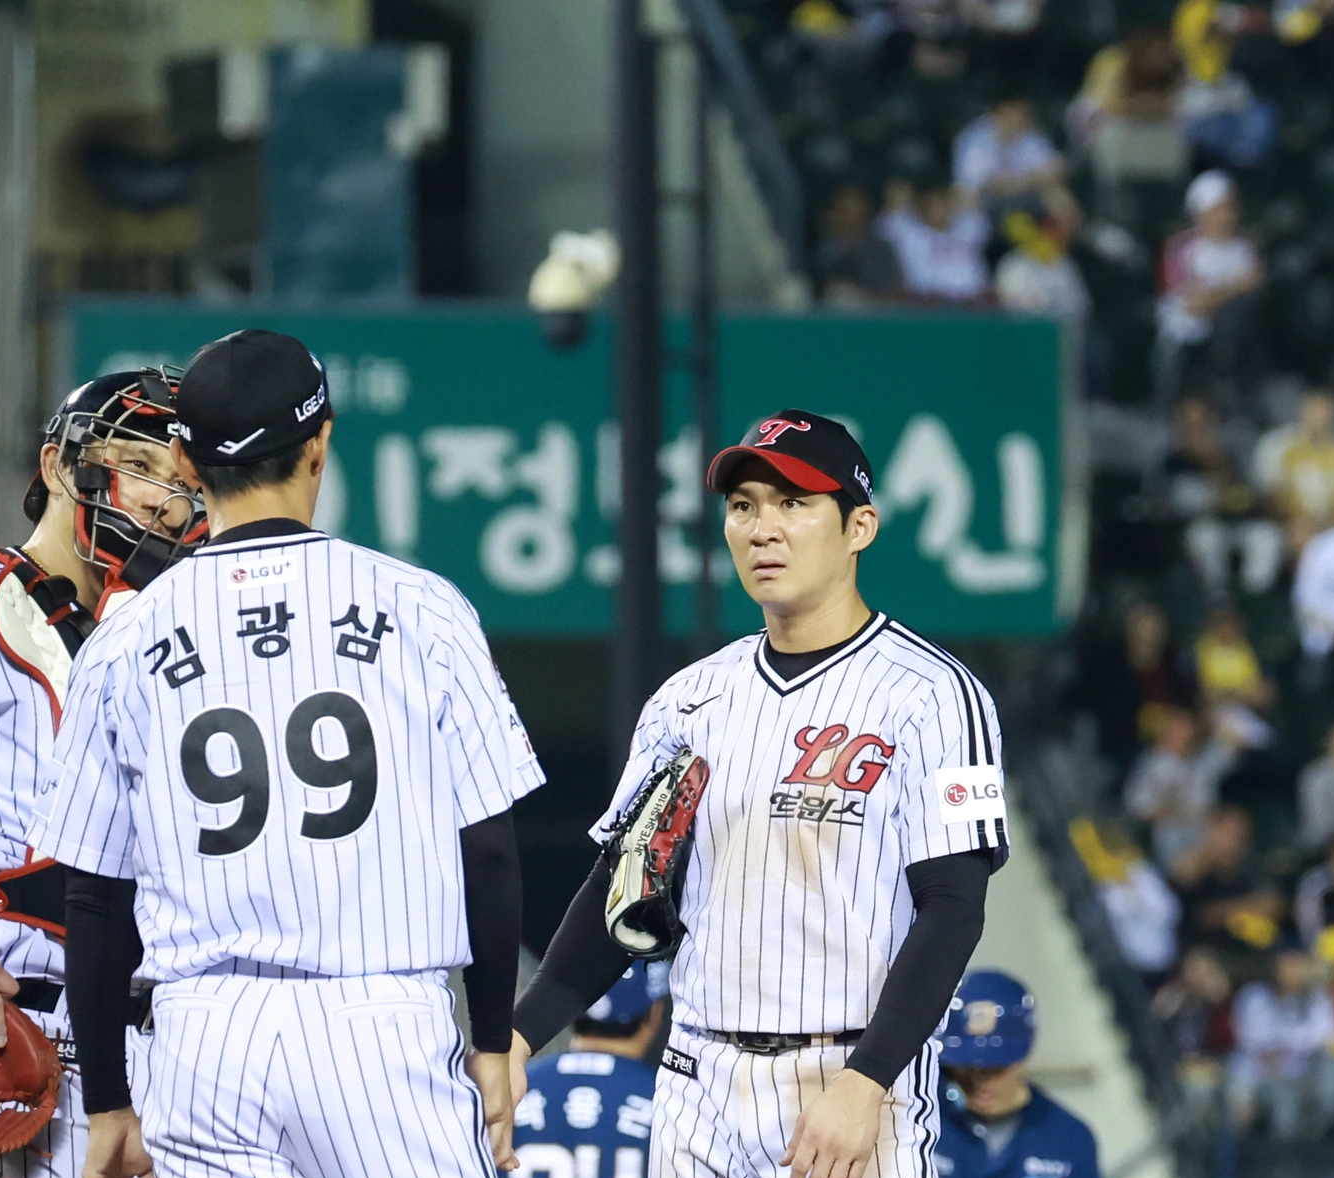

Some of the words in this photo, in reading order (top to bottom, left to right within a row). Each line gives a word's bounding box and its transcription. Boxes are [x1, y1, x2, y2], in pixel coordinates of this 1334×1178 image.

[250, 566, 270, 580] LG
[144, 601, 395, 690] 김광삼
[178, 690, 380, 860] 99
[781, 723, 897, 795] LG
[971, 783, 999, 801] LG
